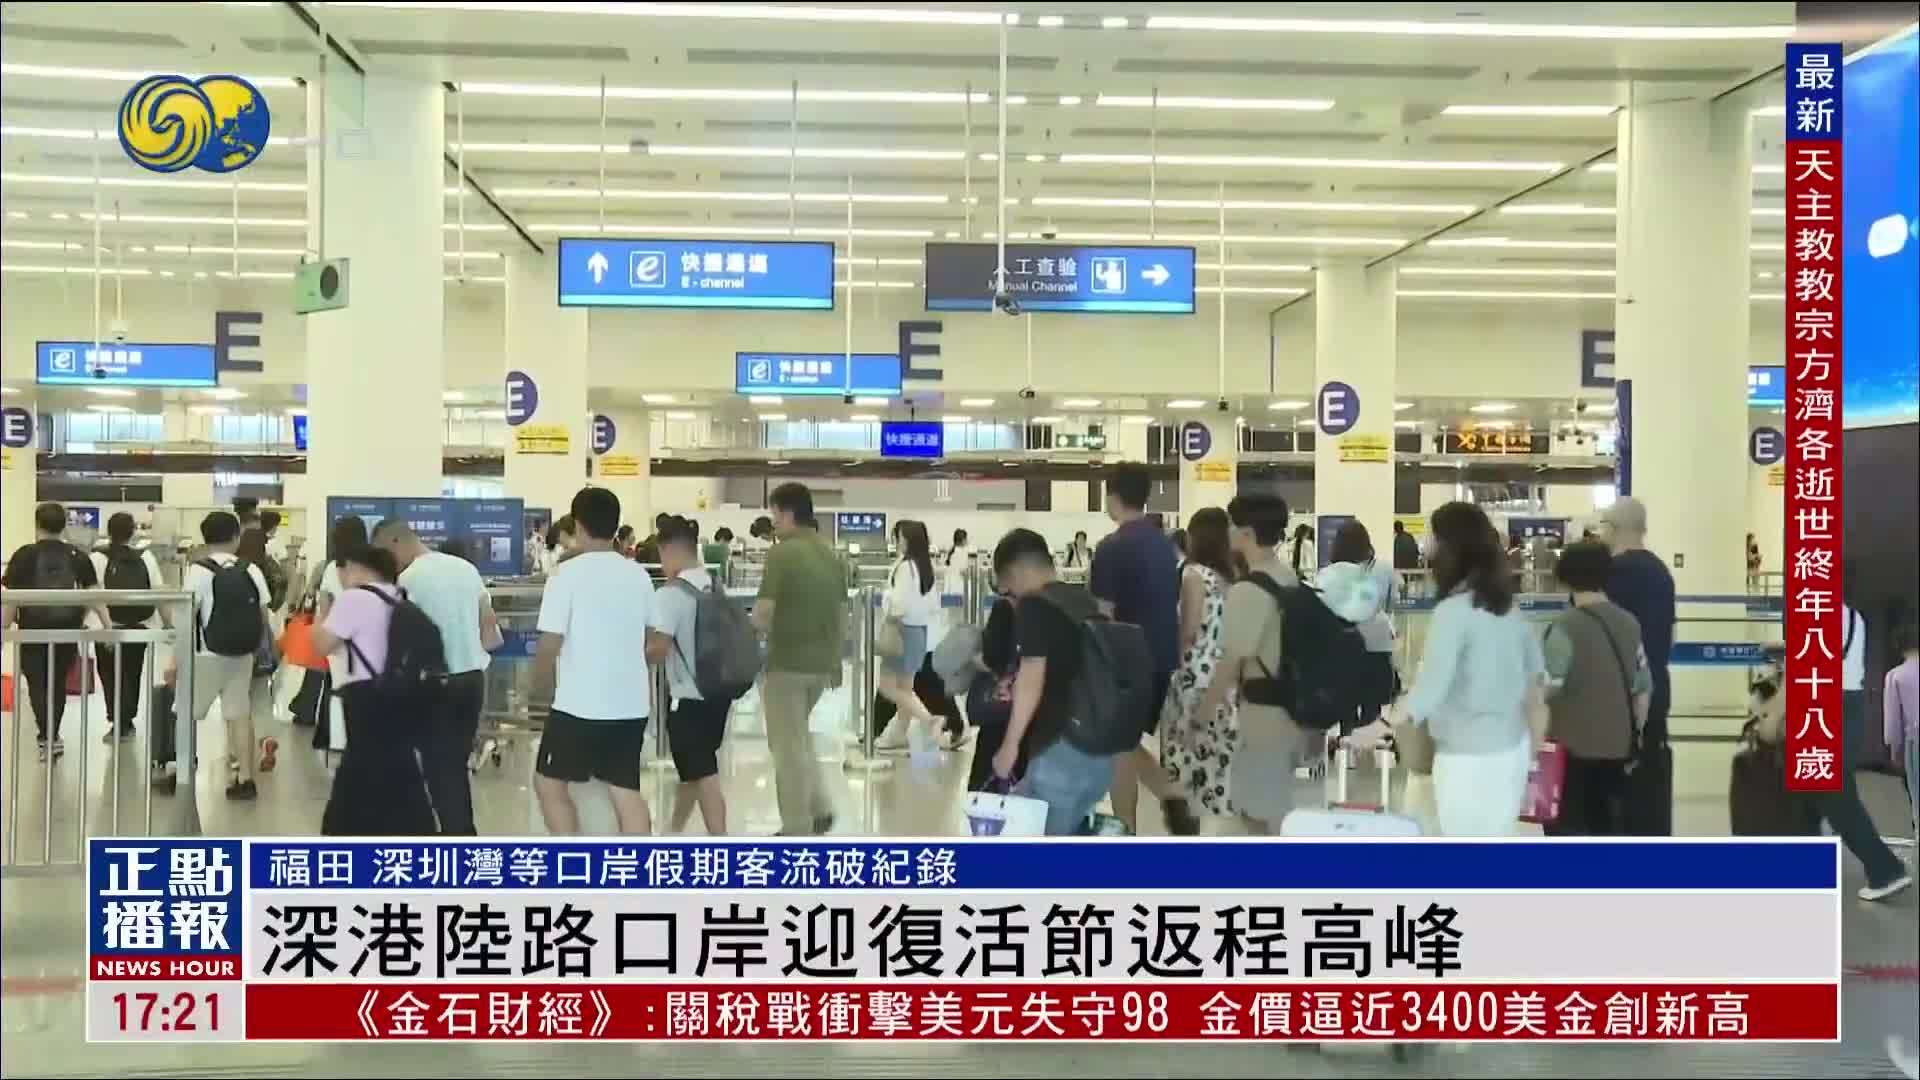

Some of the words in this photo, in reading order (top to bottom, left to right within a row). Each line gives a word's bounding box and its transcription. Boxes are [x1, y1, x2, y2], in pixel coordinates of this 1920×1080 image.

[988, 280, 1028, 292] Mnual
[1031, 281, 1078, 293] Channel
[215, 311, 263, 372] E
[899, 321, 943, 380] E
[507, 381, 525, 417] E
[1323, 391, 1347, 426] E
[5, 414, 26, 441] E
[594, 421, 607, 447] E
[1185, 428, 1202, 455] E
[1755, 433, 1775, 458] E
